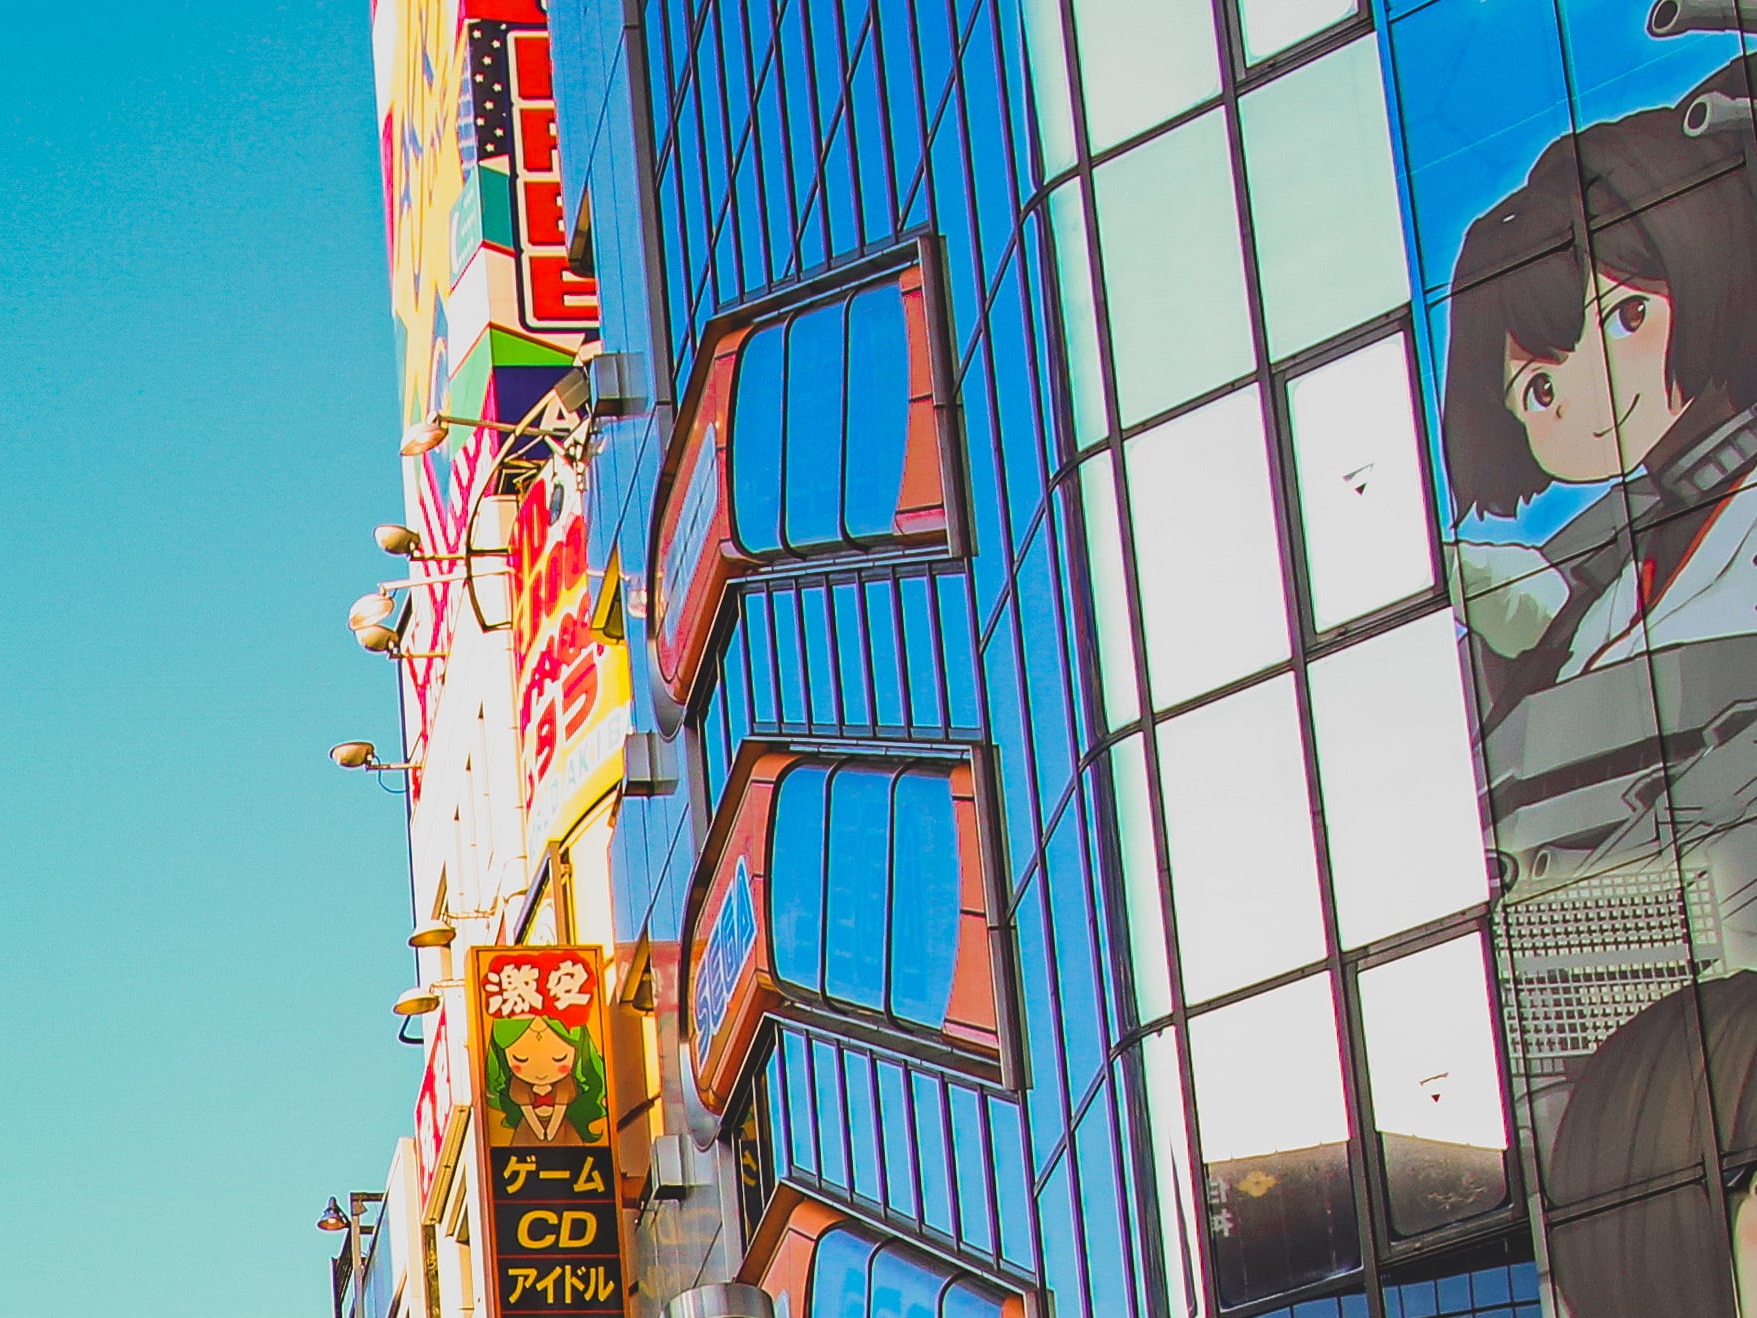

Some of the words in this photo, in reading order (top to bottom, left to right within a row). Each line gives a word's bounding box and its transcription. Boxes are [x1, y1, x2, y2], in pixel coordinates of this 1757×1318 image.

[694, 856, 756, 1066] SEGA
[486, 959, 591, 1015] 激安
[503, 1156, 606, 1194] ゲーム
[516, 1210, 596, 1249] CD
[508, 1265, 614, 1305] アイドル
